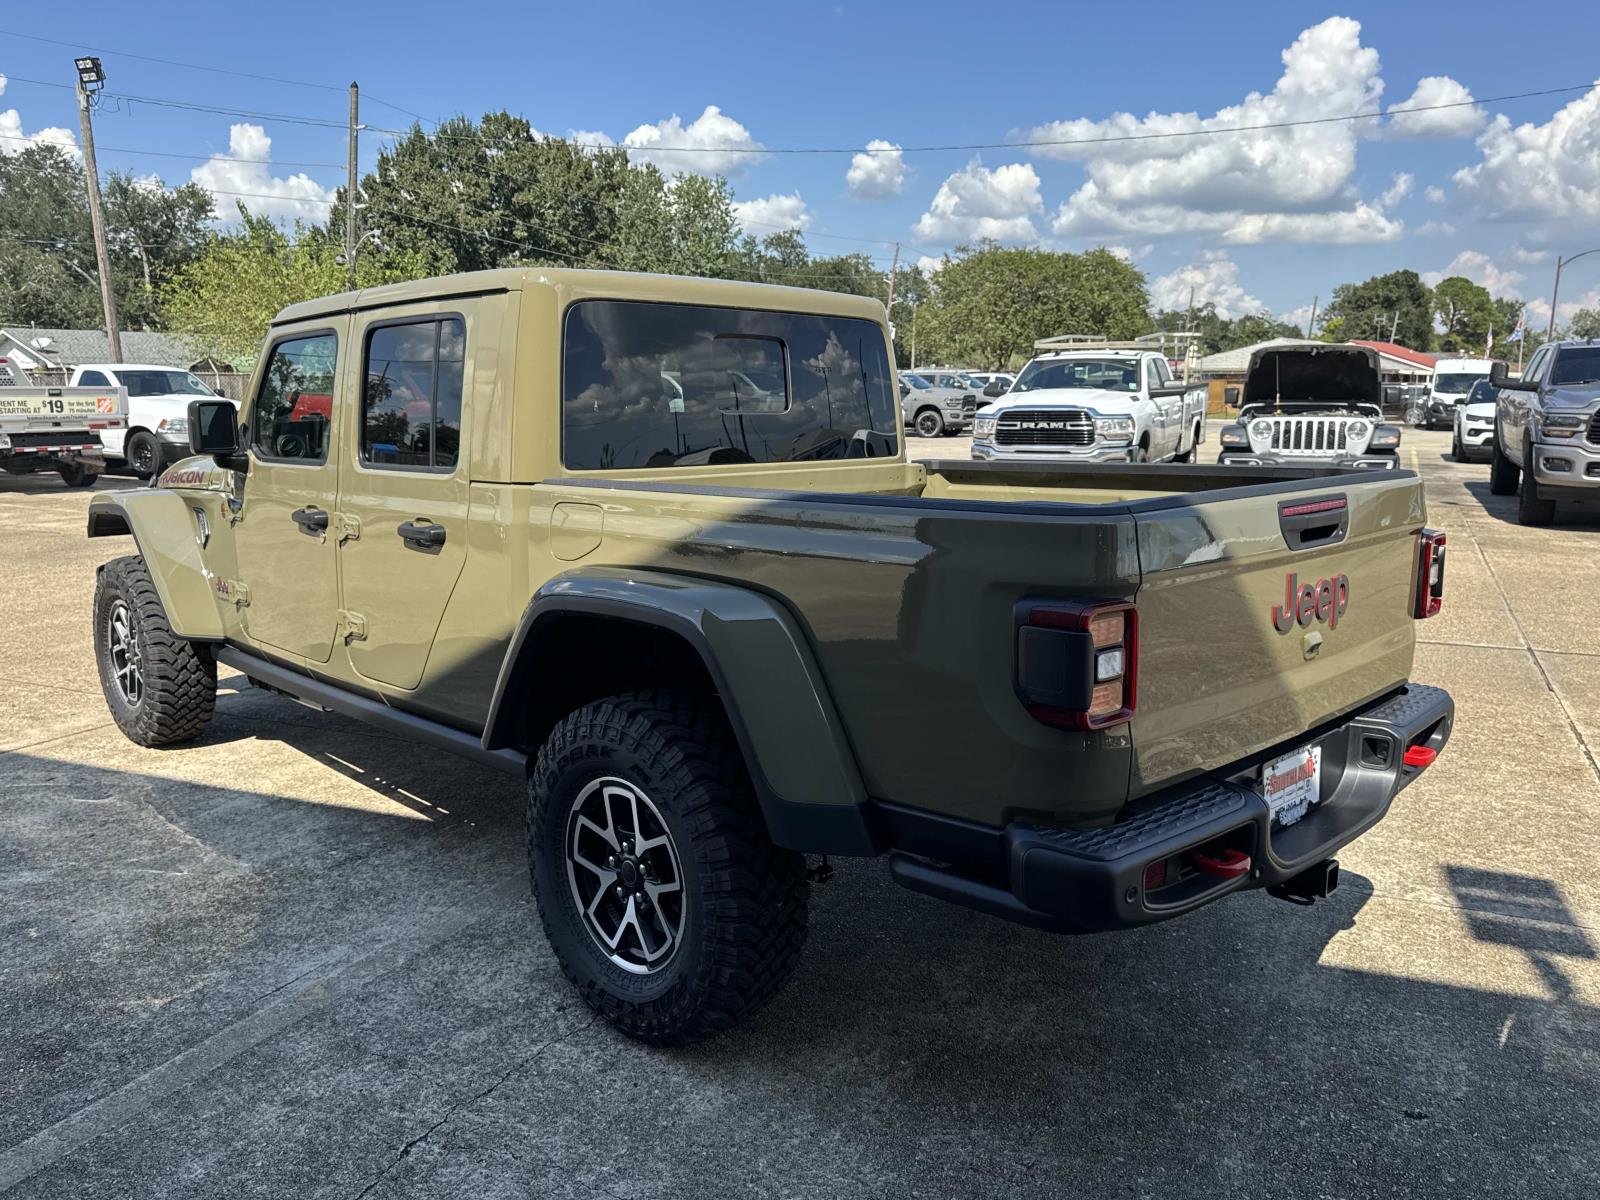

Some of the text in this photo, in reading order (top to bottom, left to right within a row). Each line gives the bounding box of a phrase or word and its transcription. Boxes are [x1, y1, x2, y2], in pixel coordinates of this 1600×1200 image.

[42, 399, 64, 414] $19
[160, 471, 205, 484] RUBICON
[1272, 572, 1349, 635] Jeep
